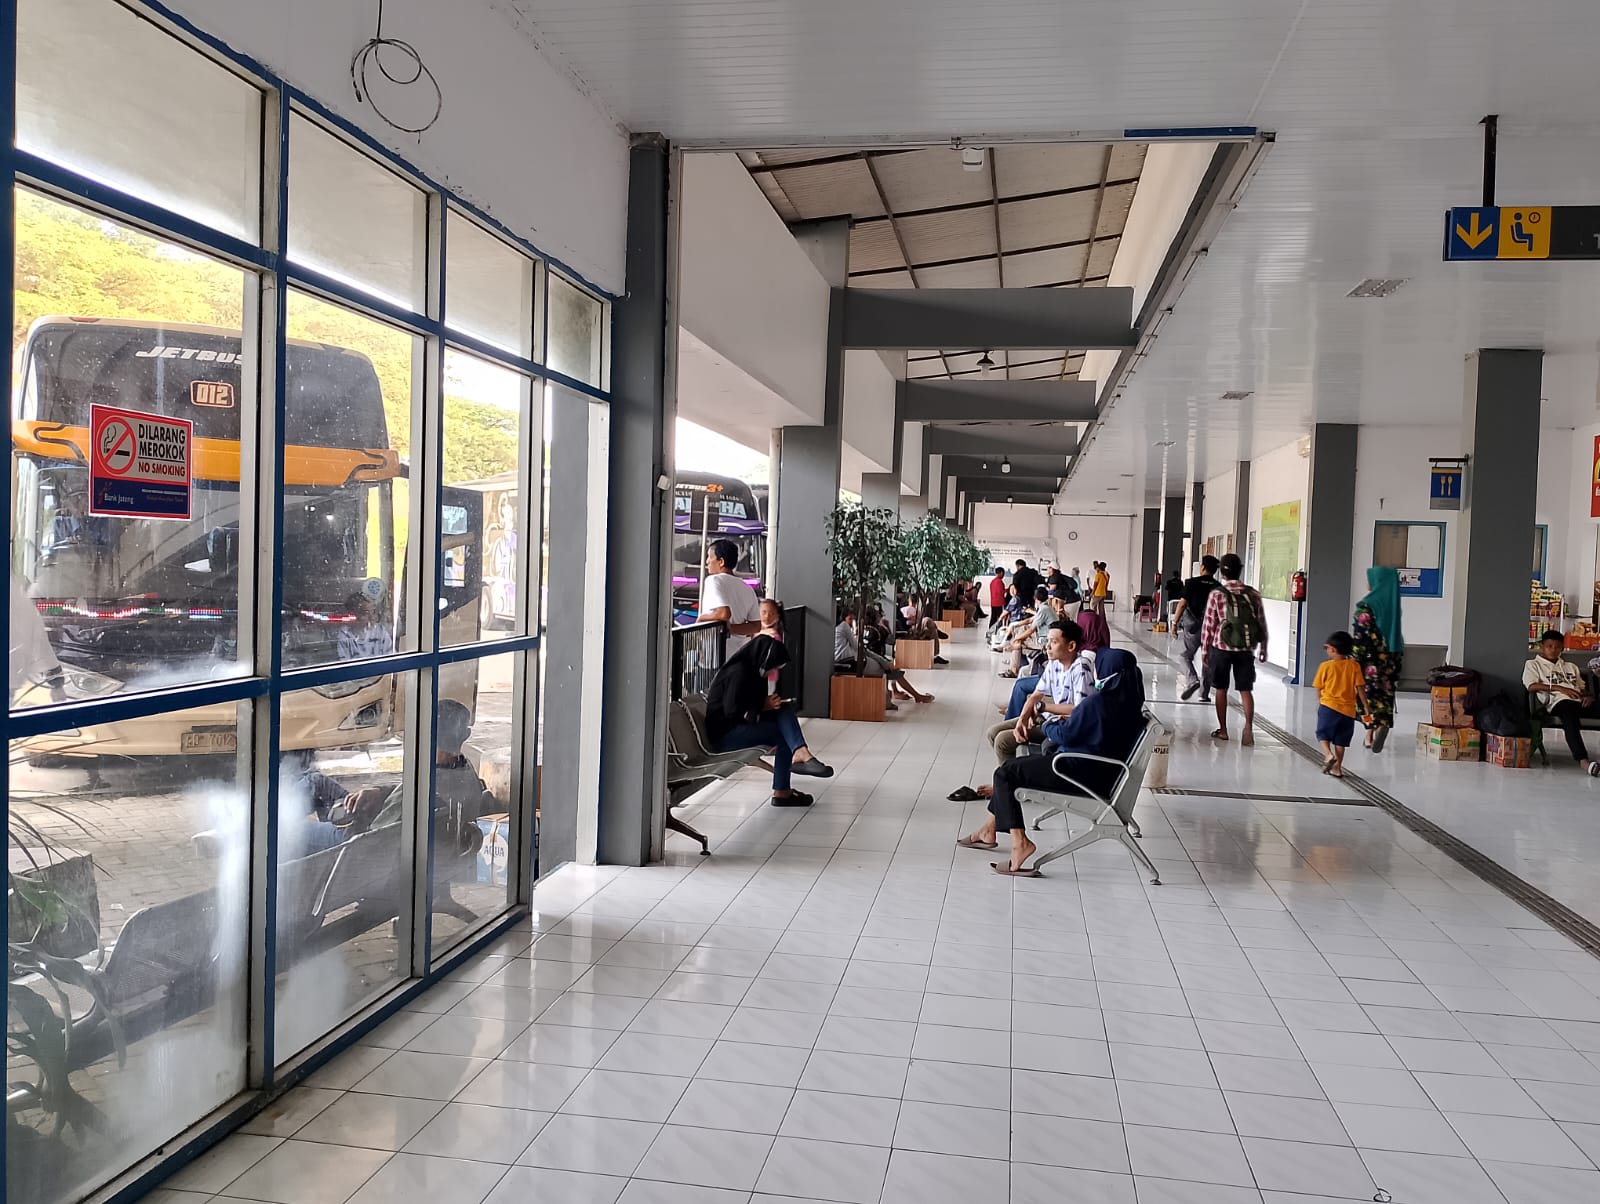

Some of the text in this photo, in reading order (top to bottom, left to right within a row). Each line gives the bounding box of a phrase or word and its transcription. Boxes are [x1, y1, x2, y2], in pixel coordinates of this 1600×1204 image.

[196, 383, 228, 405] 012
[138, 423, 185, 444] DILARANG
[138, 441, 185, 460] MEROKOK
[138, 462, 185, 476] NO SMOKING
